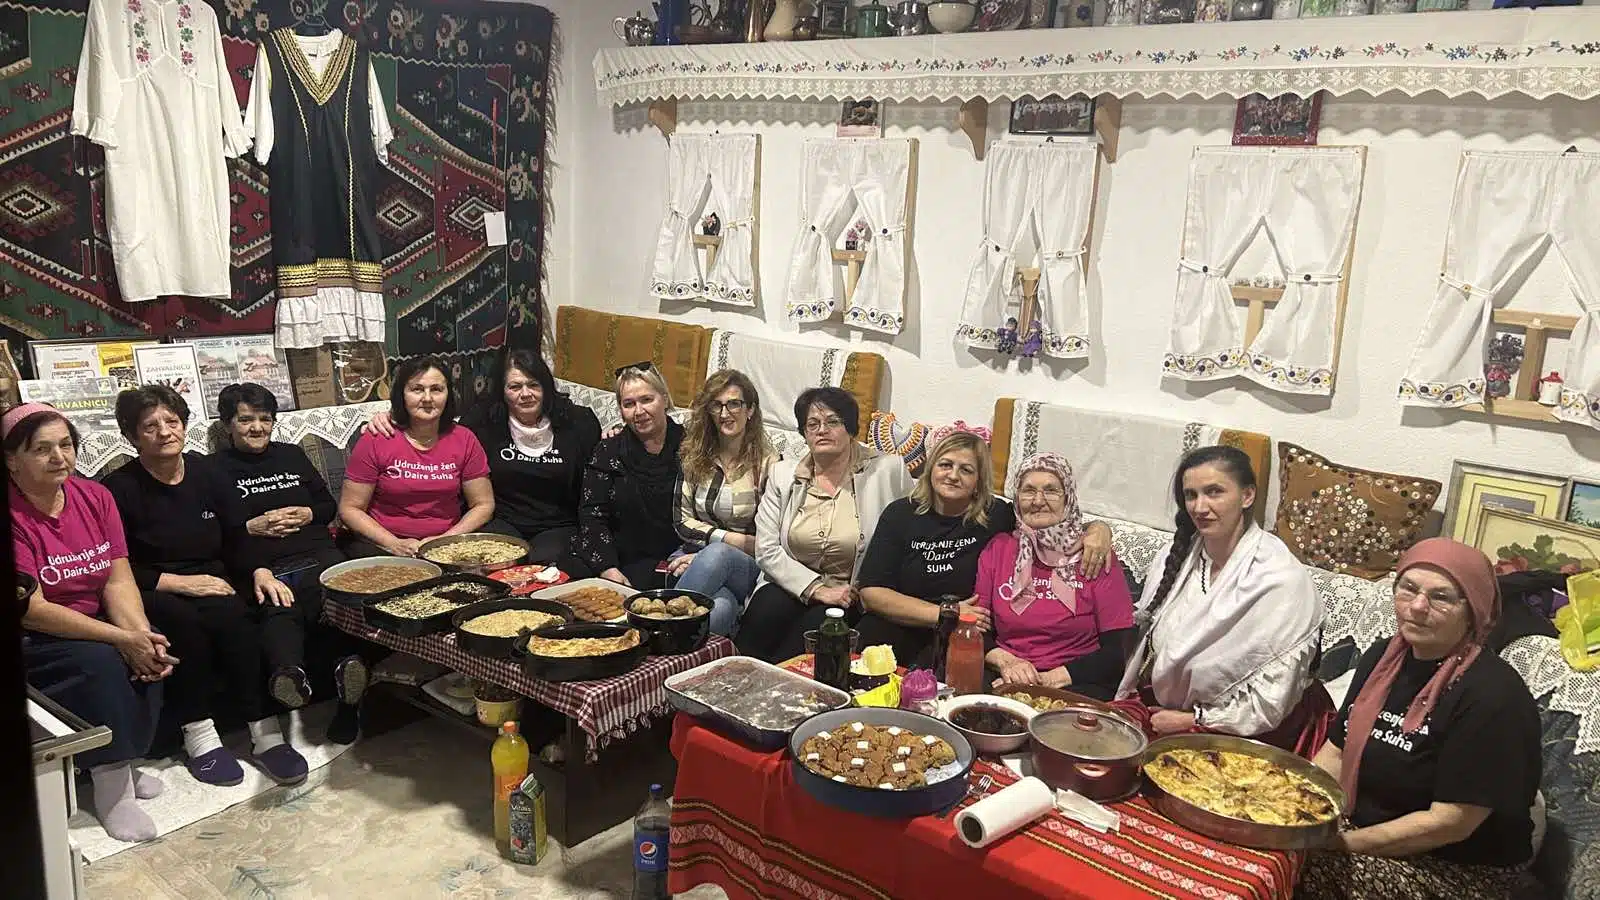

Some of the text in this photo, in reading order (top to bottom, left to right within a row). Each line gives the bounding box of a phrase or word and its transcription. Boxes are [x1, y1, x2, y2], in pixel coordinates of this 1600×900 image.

[517, 453, 540, 462] Daire
[394, 459, 439, 472] Udruženje
[404, 470, 453, 480] Daire Suha
[251, 480, 300, 493] Daire Suha
[89, 559, 111, 573] Suha
[926, 563, 953, 573] SUHA
[1382, 729, 1413, 752] Suha
